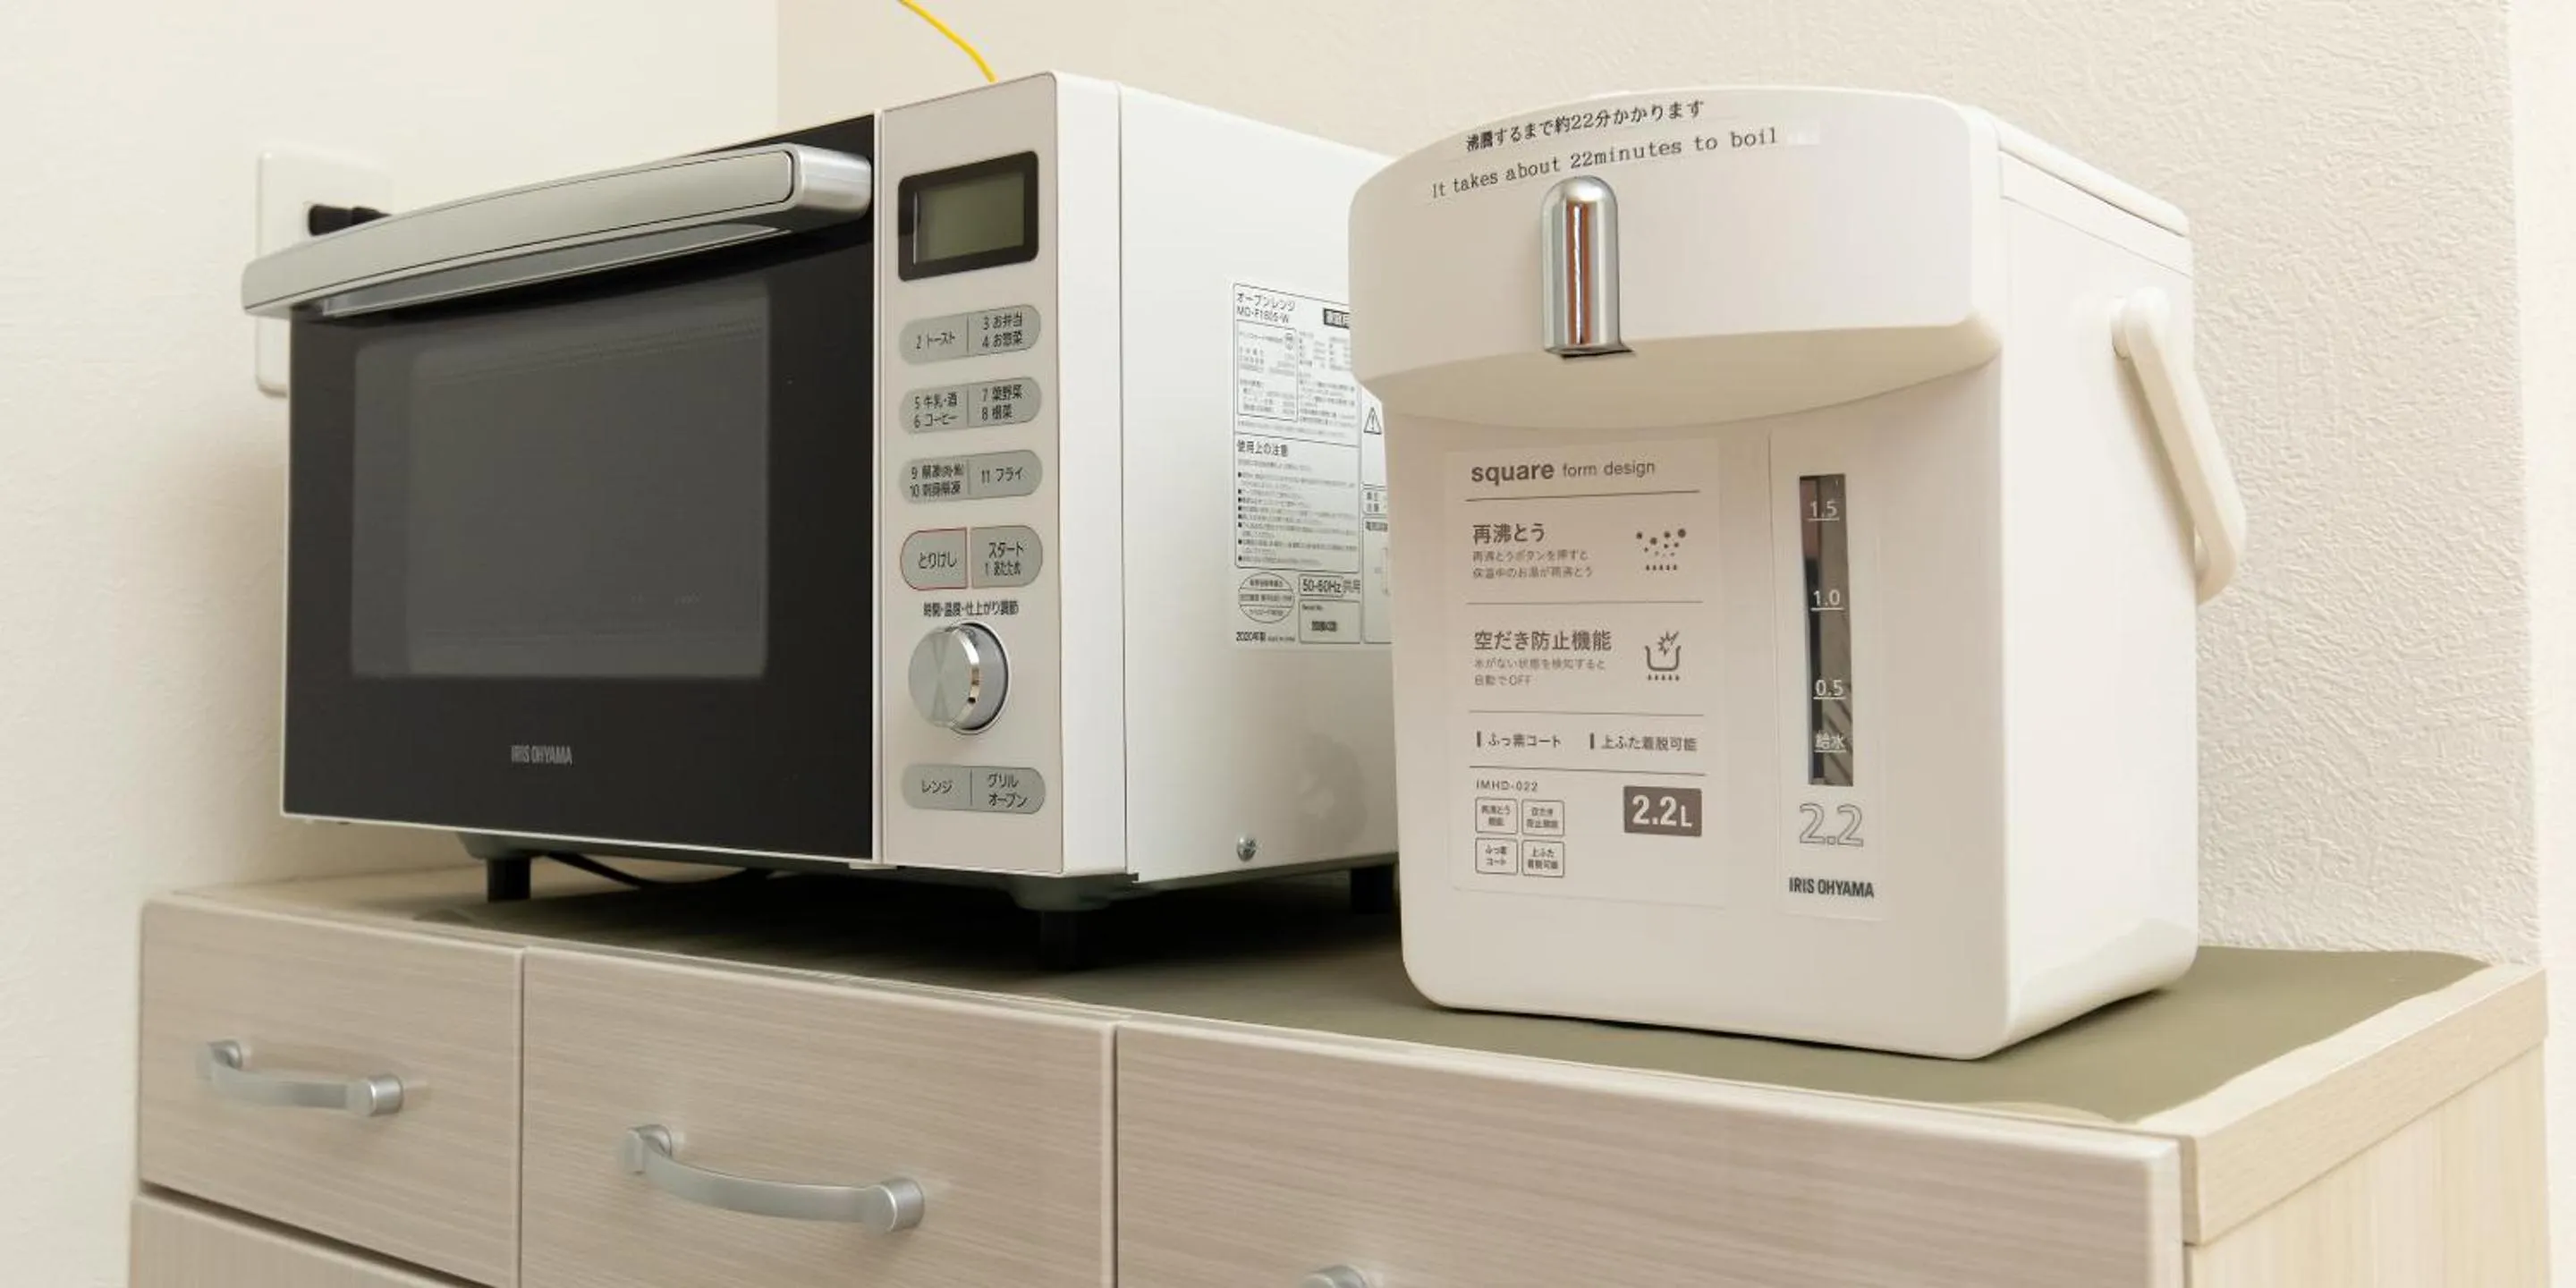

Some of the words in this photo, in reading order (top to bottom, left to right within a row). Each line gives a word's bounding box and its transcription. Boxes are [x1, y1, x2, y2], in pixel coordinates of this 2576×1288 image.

[1466, 99, 1705, 153] 沸騰するまで約22分かかります
[1431, 182, 1446, 199] It
[1453, 170, 1499, 194] takes
[1505, 156, 1561, 182] about
[1570, 140, 1682, 170] 22minutes
[1694, 135, 1718, 152] to
[1730, 127, 1777, 148] boil
[983, 317, 989, 330] 3
[992, 311, 1022, 328] お弁当
[916, 335, 922, 349] 2
[927, 332, 955, 349] トースト
[982, 335, 989, 348] 4
[993, 331, 1022, 347] お惣菜
[914, 396, 920, 409] 5
[914, 415, 920, 428] 6
[924, 413, 958, 428] コーヒー
[982, 408, 988, 420] 8
[911, 466, 918, 479] 9
[981, 470, 990, 483] 11
[996, 467, 1023, 482] フライ
[1471, 462, 1555, 486] square
[1563, 462, 1597, 478] form
[1604, 460, 1655, 479] design
[910, 483, 919, 496] 10
[1809, 500, 1837, 518] 1.5
[1472, 522, 1546, 545] 再沸とう
[988, 541, 1024, 558] スタート
[918, 551, 957, 569] とりけし
[1813, 589, 1841, 606] 1.0
[1474, 630, 1612, 651] 空だき防止機能
[1815, 679, 1844, 696] 0.5
[1487, 732, 1562, 748] ふっ素コート
[1601, 735, 1698, 751] 上ふた着脱可能
[1816, 733, 1846, 750] 給水
[531, 745, 573, 766] OHYAMA
[921, 778, 953, 794] レンジ
[987, 773, 1020, 788] グリル
[1476, 780, 1538, 792] IMHD-022
[1631, 794, 1693, 828] 2.2L
[1799, 802, 1864, 847] 2.2
[1789, 877, 1815, 894] IRIS
[1818, 878, 1875, 898] OHYAMA
